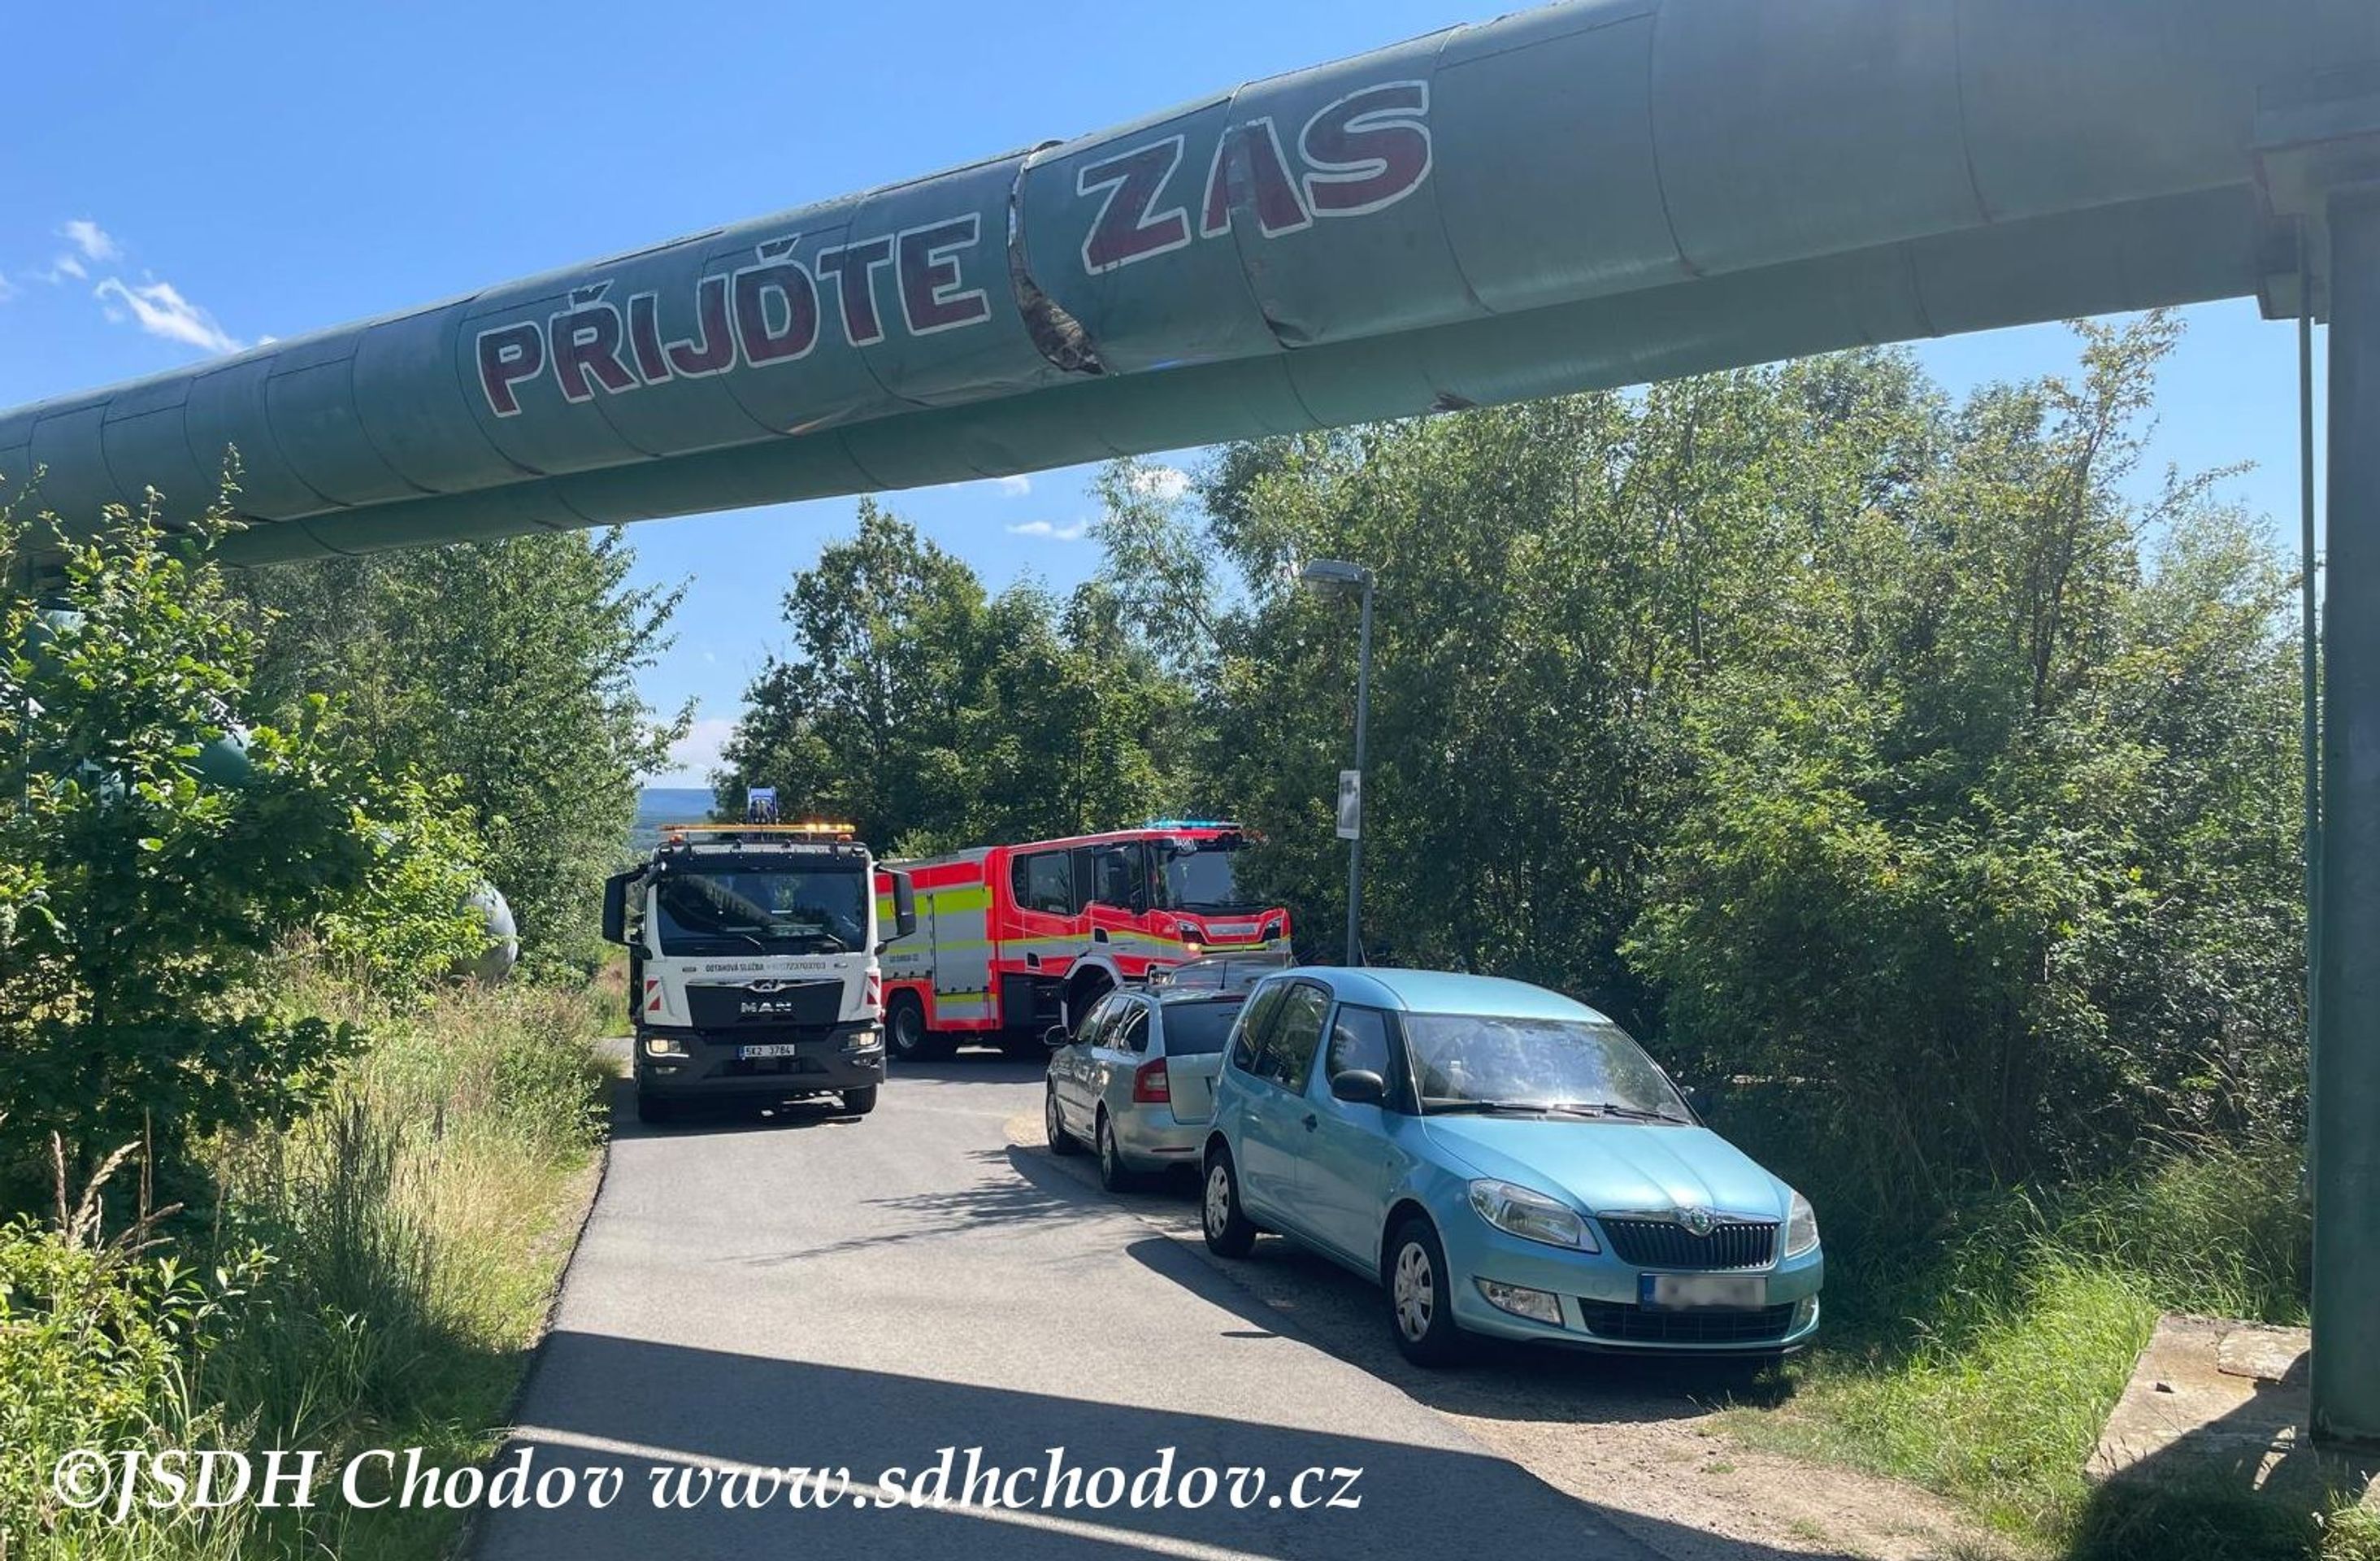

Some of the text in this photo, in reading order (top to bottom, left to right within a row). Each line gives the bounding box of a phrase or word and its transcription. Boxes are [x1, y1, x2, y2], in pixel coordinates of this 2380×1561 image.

[476, 80, 1433, 419] PŘIJĎTE ZAS
[741, 1002, 792, 1013] MAN
